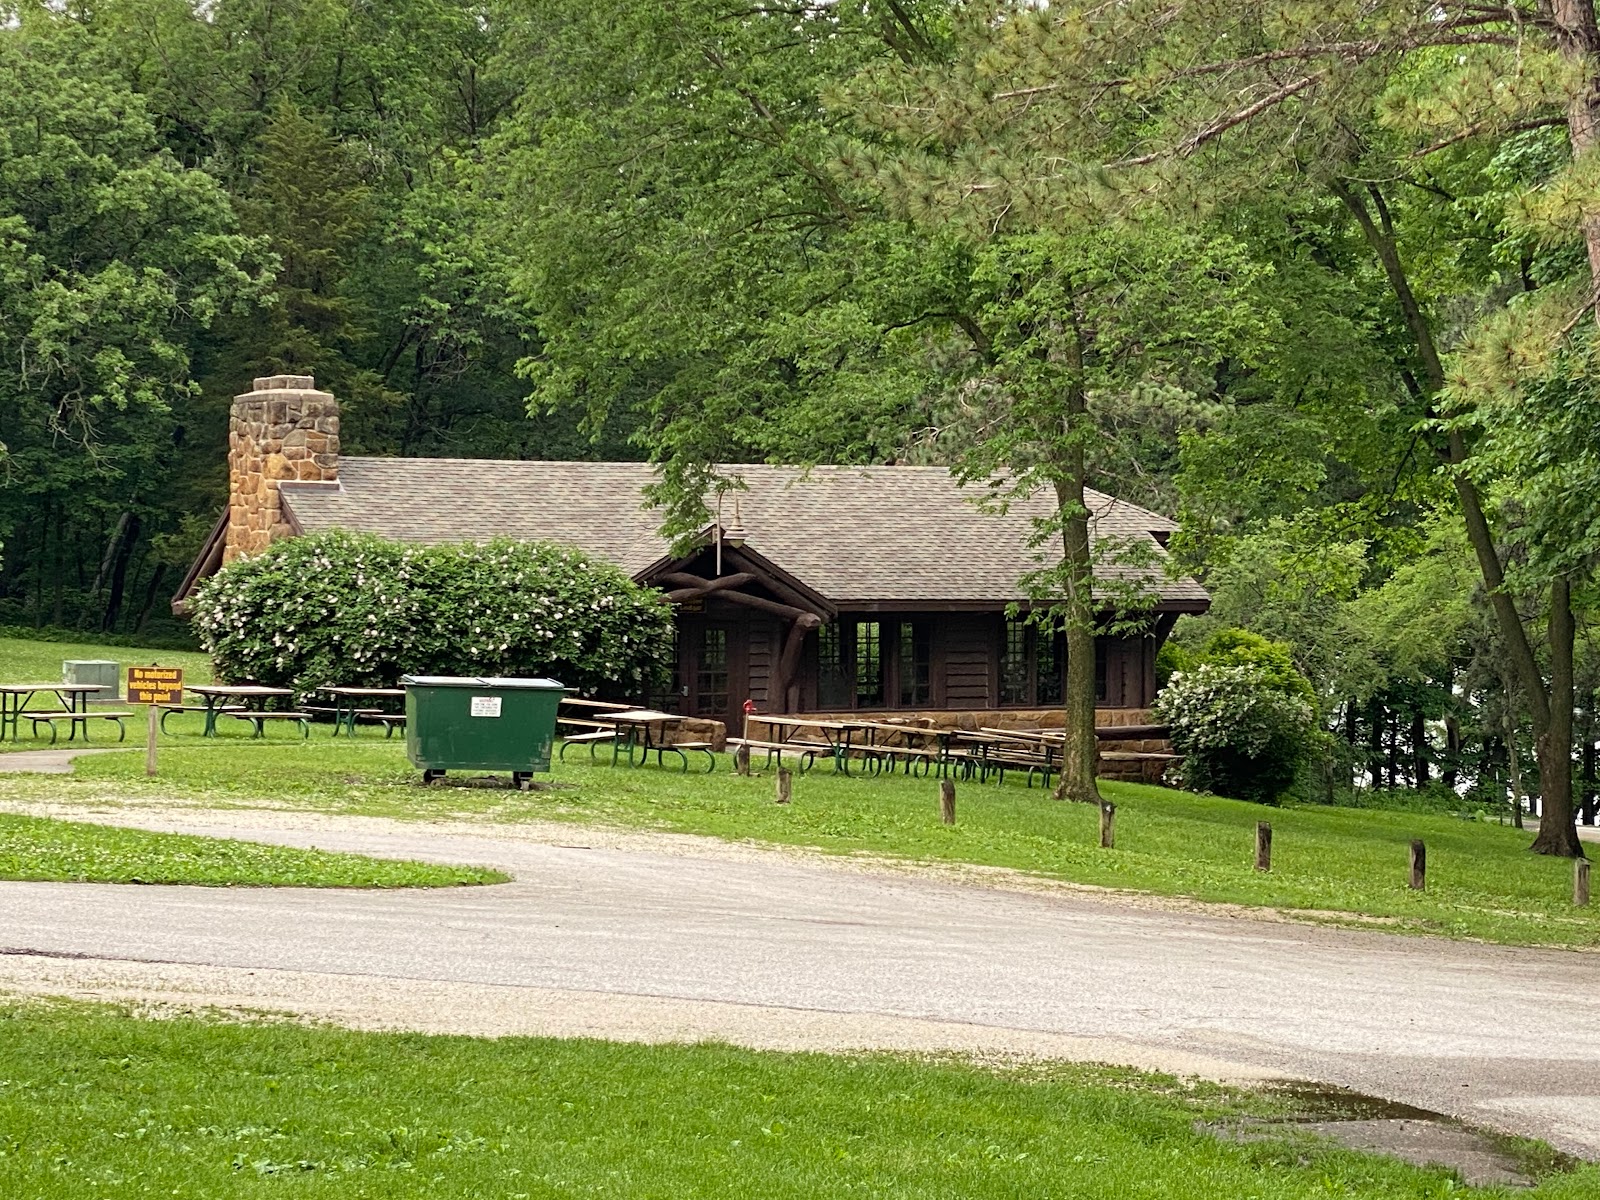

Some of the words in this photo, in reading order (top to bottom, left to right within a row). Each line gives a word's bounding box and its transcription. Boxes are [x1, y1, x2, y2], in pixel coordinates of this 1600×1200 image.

[134, 669, 143, 678] No
[144, 670, 177, 679] motorized
[130, 681, 156, 690] vehicles
[158, 681, 181, 691] beyond
[139, 691, 152, 700] this
[153, 691, 170, 703] point
